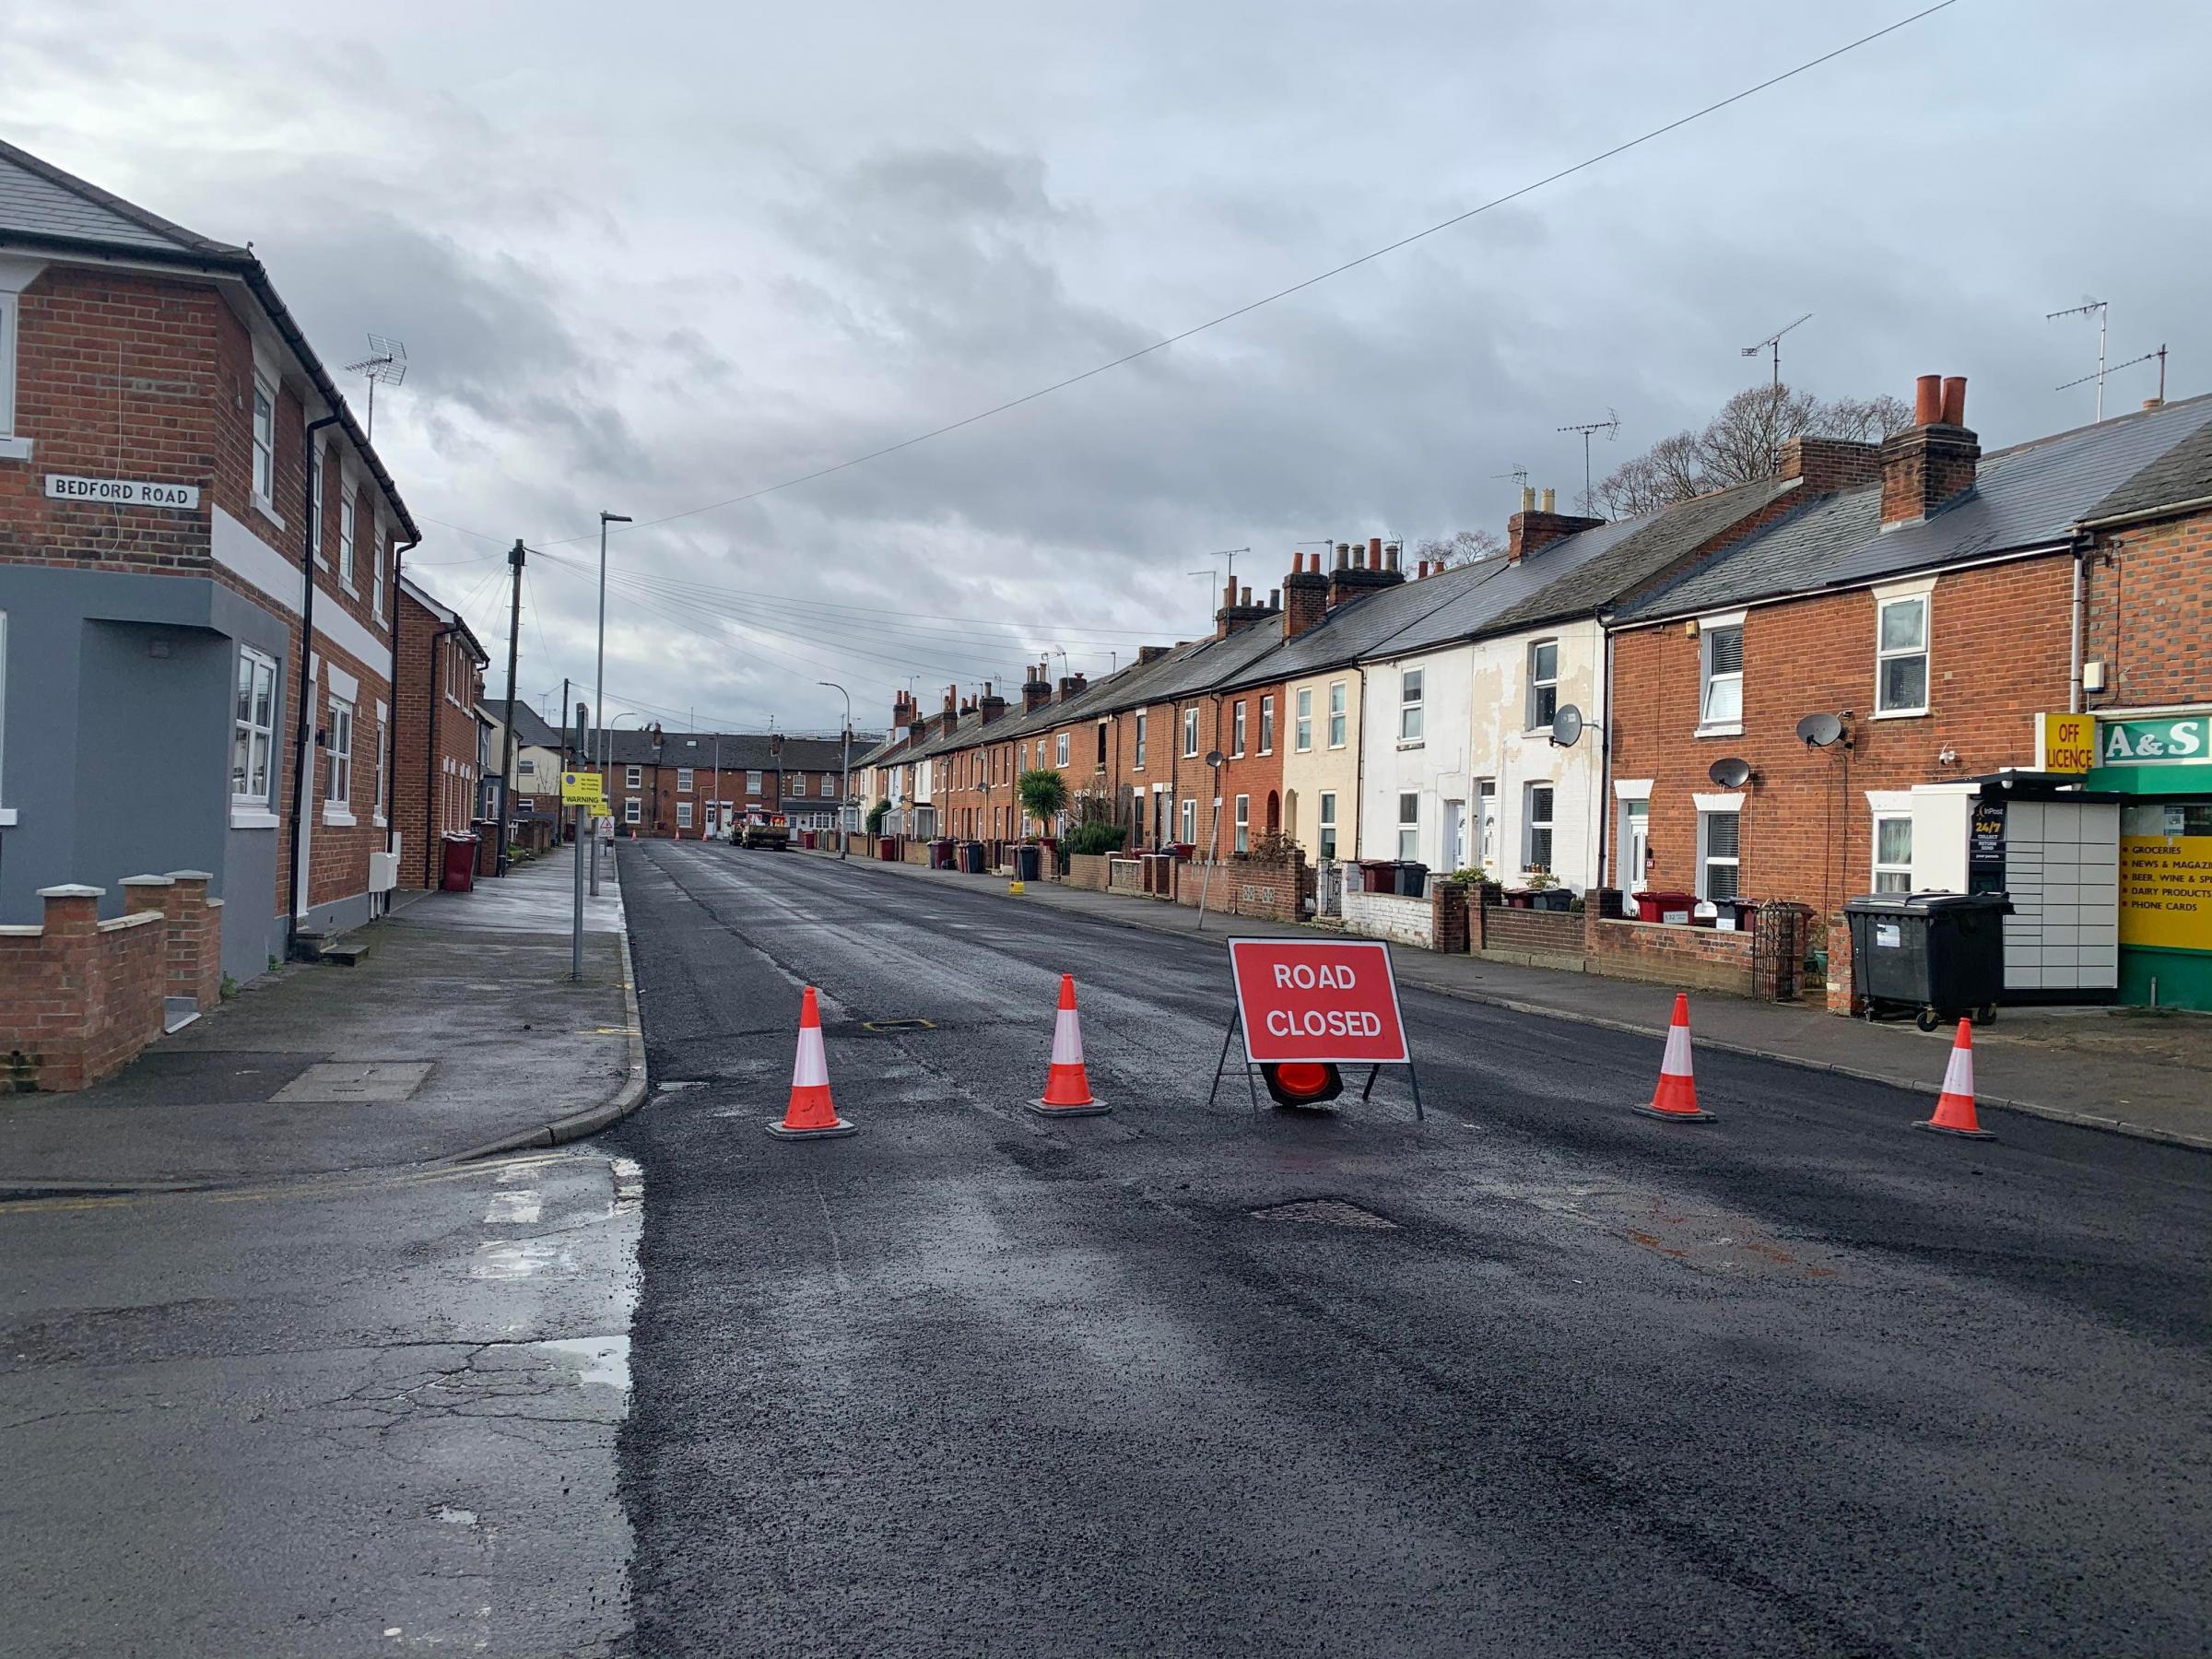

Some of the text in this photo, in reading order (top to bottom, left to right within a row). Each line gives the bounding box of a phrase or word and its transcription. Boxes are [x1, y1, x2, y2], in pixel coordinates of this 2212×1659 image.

[55, 478, 188, 504] BEDFORD ROAD
[2058, 724, 2080, 743] OFF
[2047, 747, 2092, 769] LICENCE
[566, 795, 599, 804] WARNING
[1975, 821, 2001, 834] 24/7
[2132, 846, 2182, 854] GROCERIES
[2132, 860, 2159, 868] NEWS
[2159, 875, 2184, 883] WINE
[2131, 888, 2211, 898] DAIRY PRODUCTS
[2131, 900, 2197, 912] PHONE CARDS
[1273, 963, 1356, 989] ROAD
[1266, 1010, 1382, 1037] CLOSED
